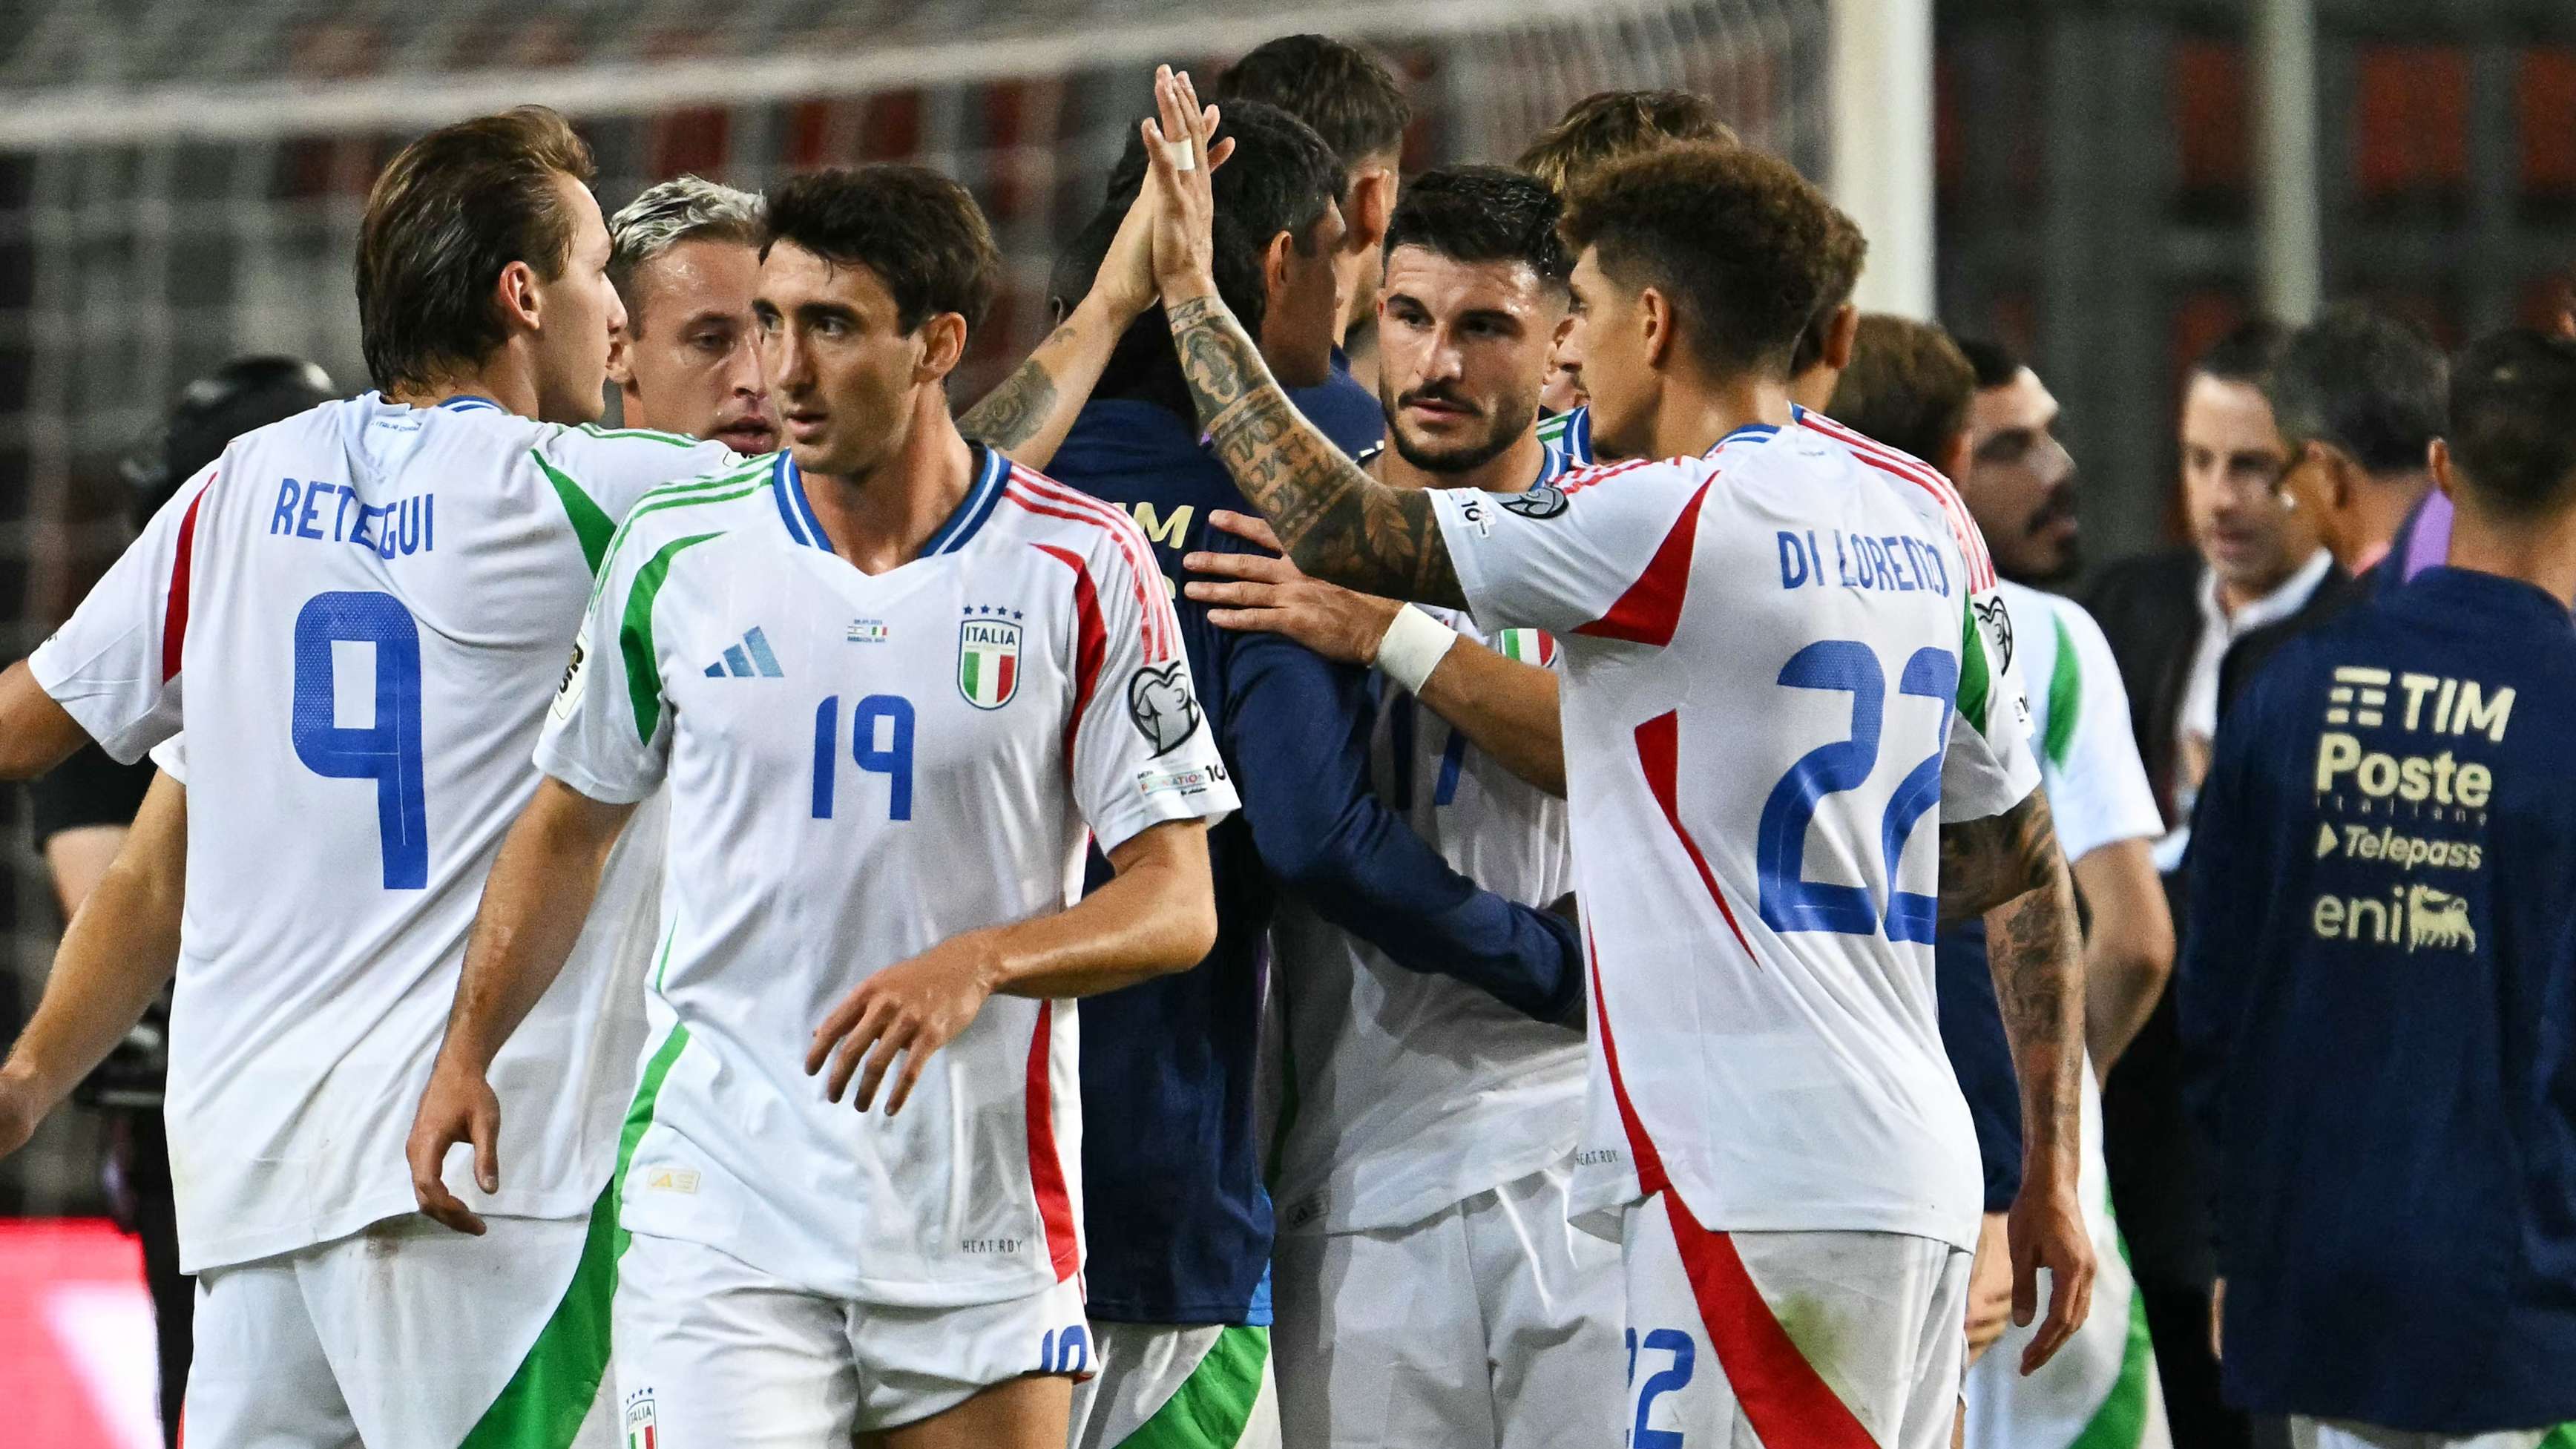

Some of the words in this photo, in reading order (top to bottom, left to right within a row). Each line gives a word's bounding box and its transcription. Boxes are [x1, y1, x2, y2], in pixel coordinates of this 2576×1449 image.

[270, 478, 434, 559] RETEGUI
[1776, 530, 1825, 589] DI
[965, 626, 1016, 646] ITALIA
[292, 591, 429, 890] 9
[2400, 671, 2518, 743] TIM
[812, 694, 916, 821] 19
[1756, 640, 1959, 945] 22
[2316, 732, 2494, 808] Poste
[2343, 824, 2484, 871] Telepass
[2313, 886, 2405, 944] eni
